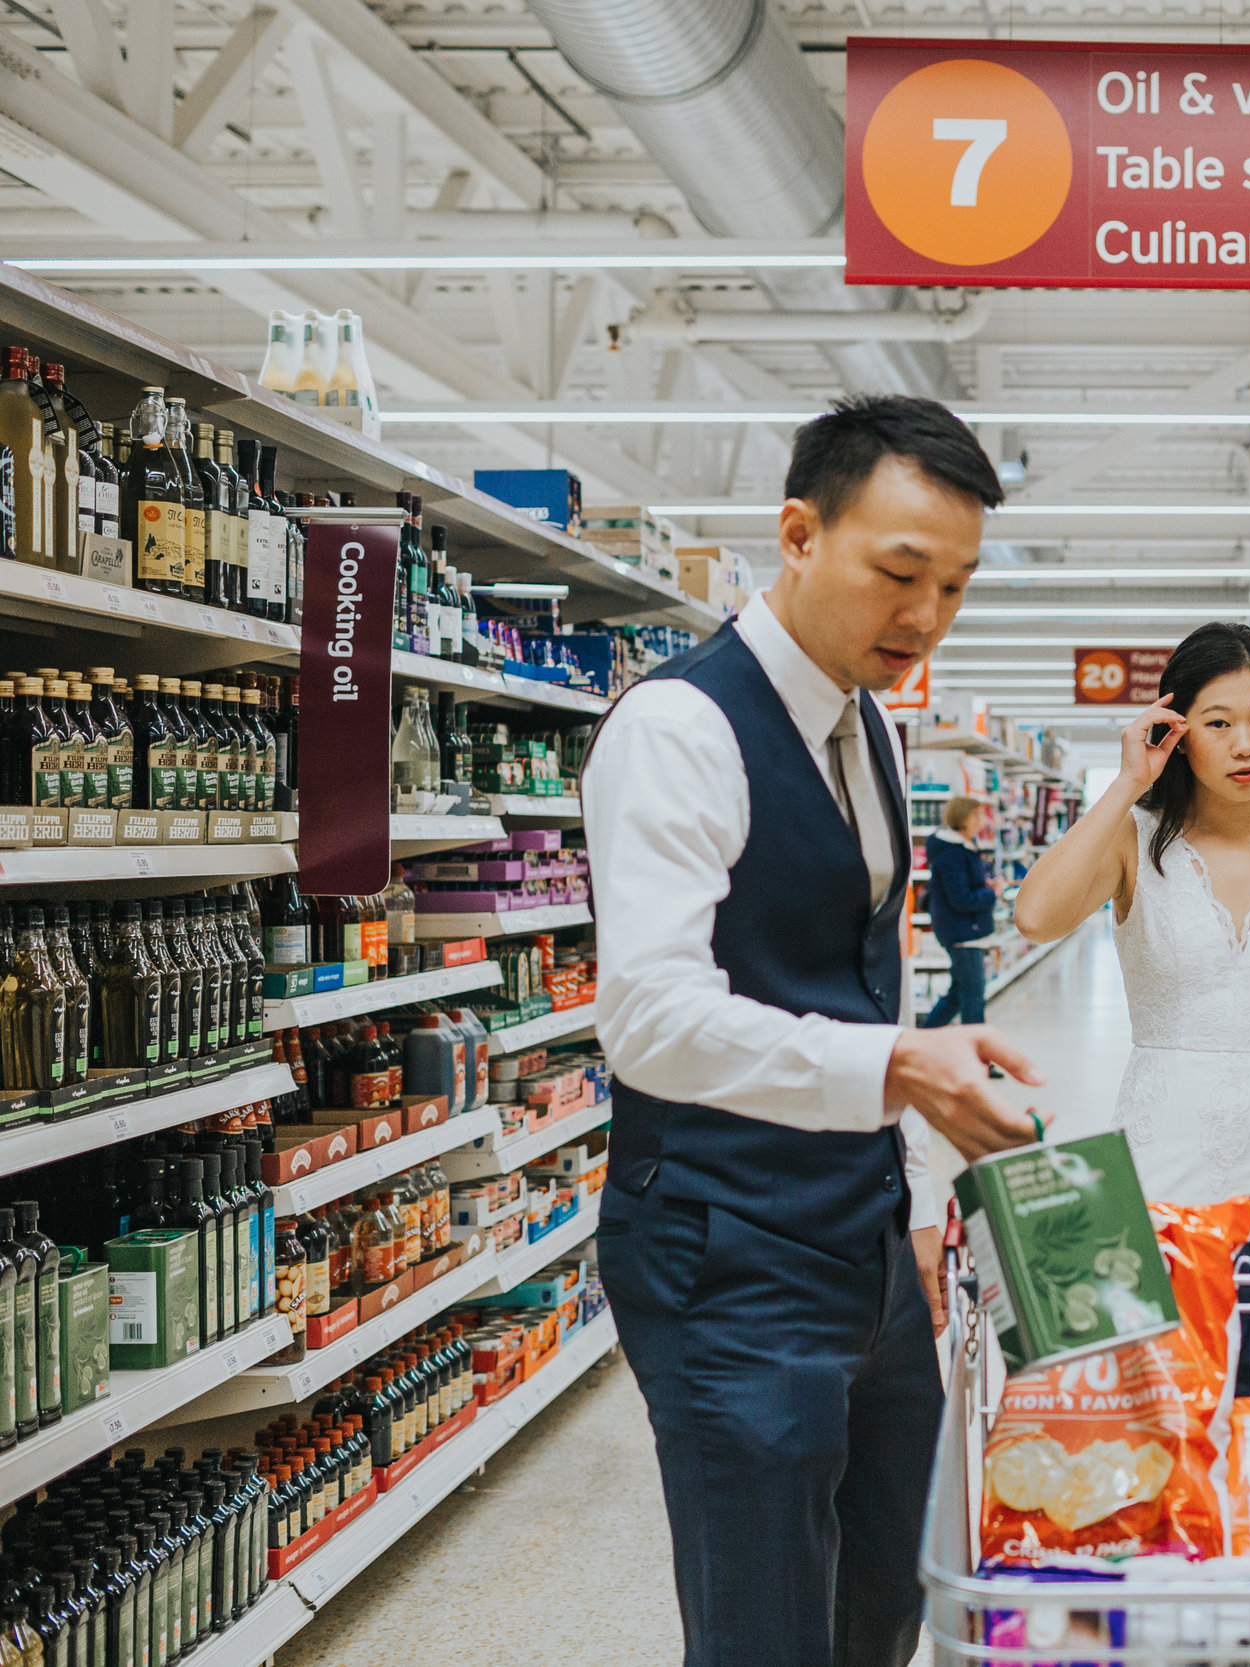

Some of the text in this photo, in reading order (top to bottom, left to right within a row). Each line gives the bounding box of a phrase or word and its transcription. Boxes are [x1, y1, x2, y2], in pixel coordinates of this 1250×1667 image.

[1097, 71, 1160, 115] Oil
[1179, 73, 1215, 115] &
[933, 118, 1007, 206] 7
[1096, 146, 1225, 190] Table
[327, 541, 365, 702] Cooking oil
[1082, 663, 1124, 689] 20
[79, 814, 110, 823] FILIPPO
[129, 816, 157, 825] FILIPPO
[73, 824, 114, 838] BERIO
[123, 825, 157, 838] BERIO
[169, 827, 199, 838] BERIO
[214, 826, 242, 838] BERIO
[250, 824, 276, 836] BERIO
